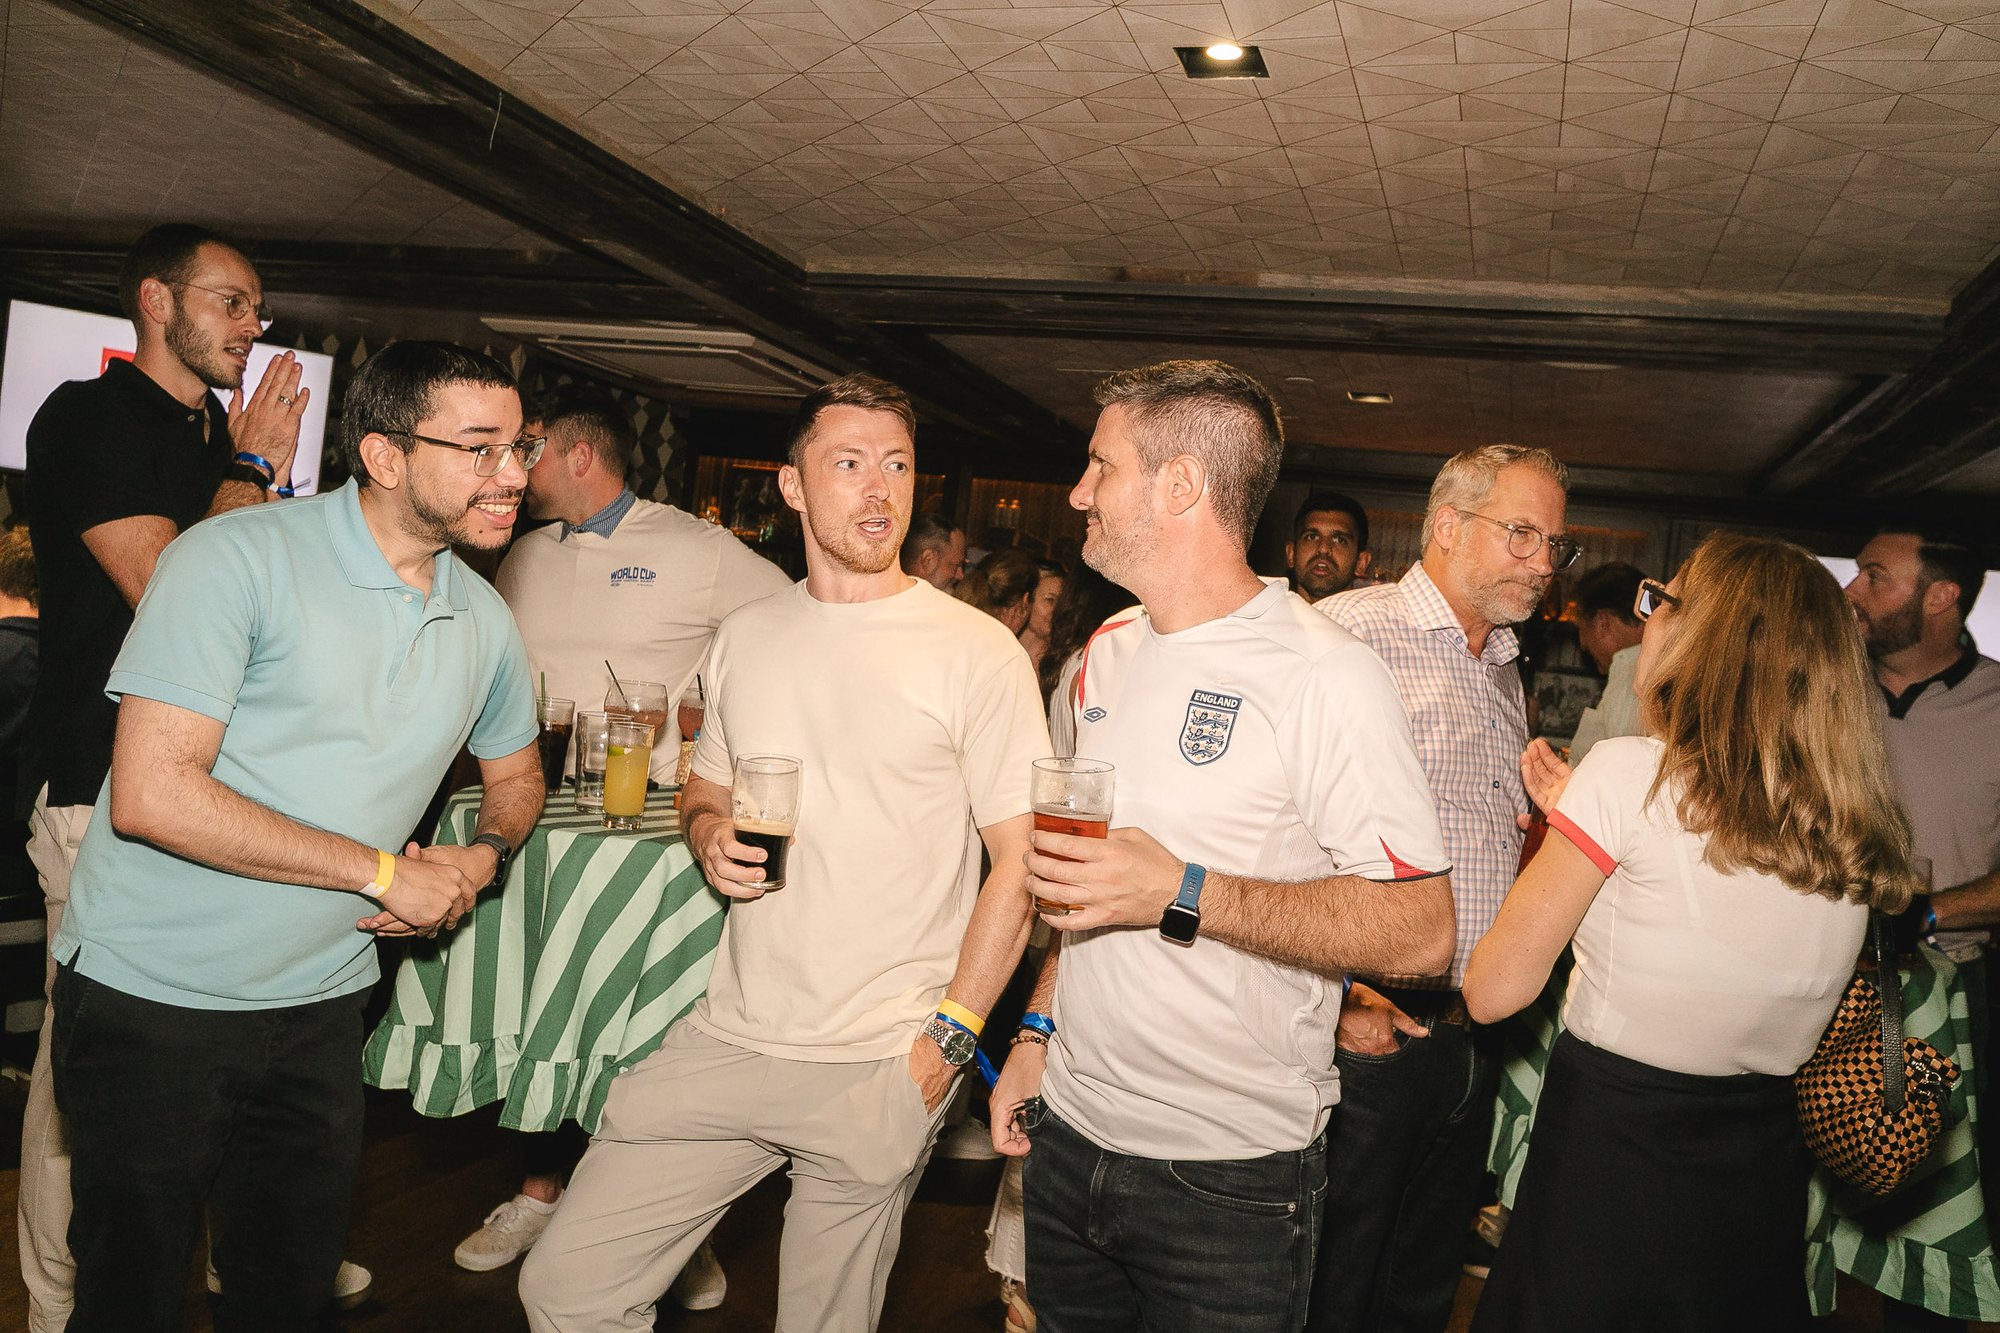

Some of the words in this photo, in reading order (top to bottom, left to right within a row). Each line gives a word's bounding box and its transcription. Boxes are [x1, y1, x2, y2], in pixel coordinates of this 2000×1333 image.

[611, 567, 639, 580] WORLD
[640, 568, 657, 580] CUP
[1193, 692, 1239, 708] ENGLAND
